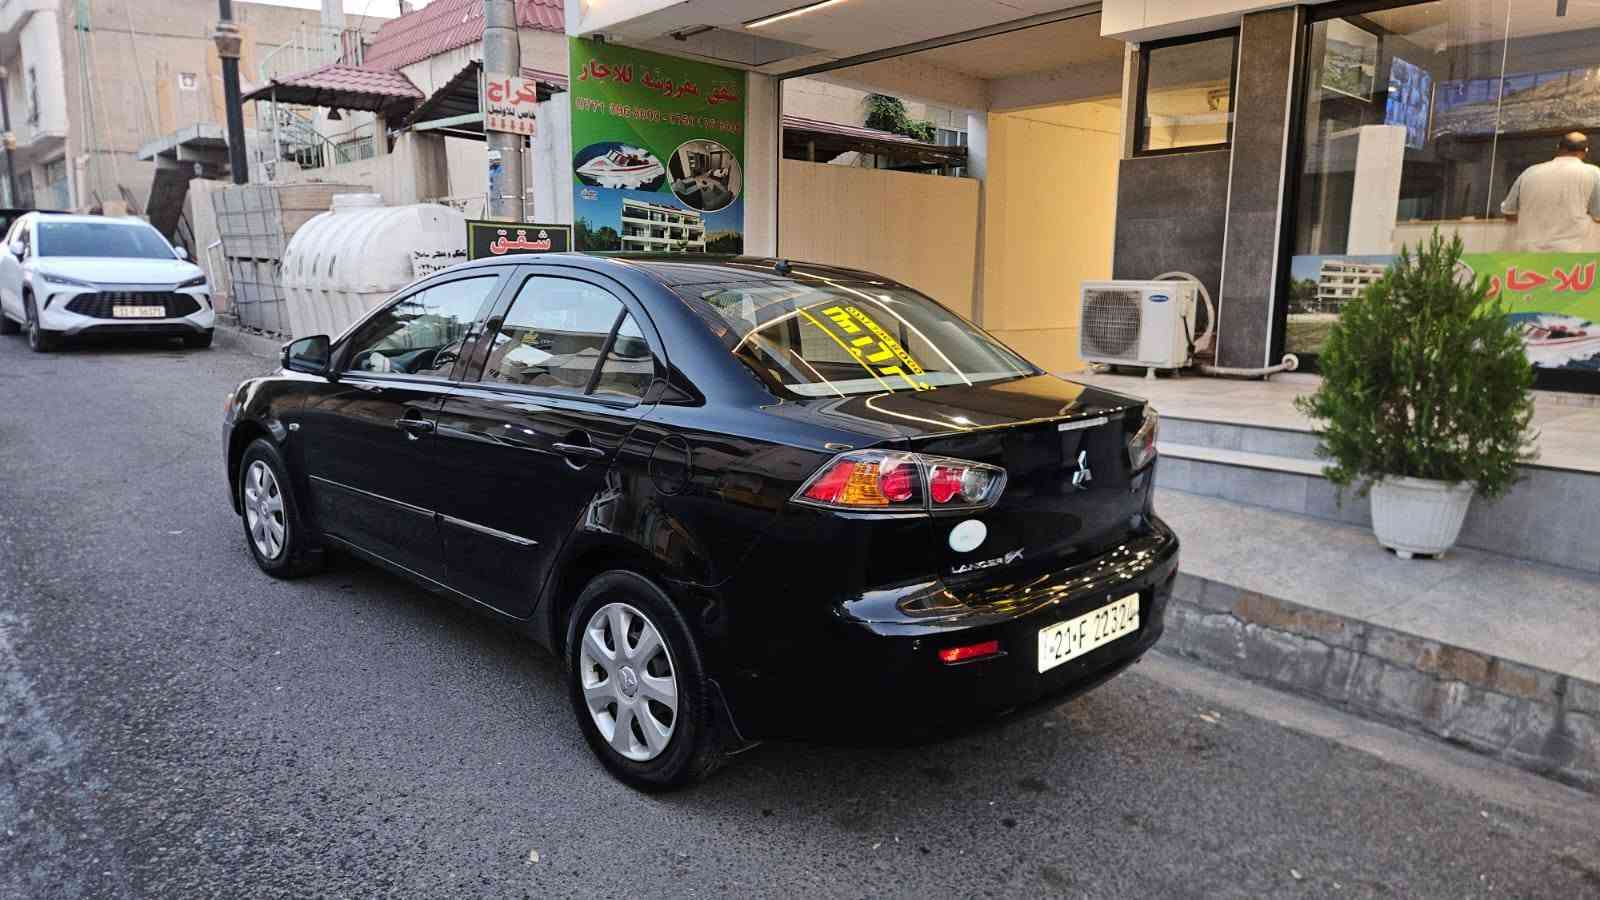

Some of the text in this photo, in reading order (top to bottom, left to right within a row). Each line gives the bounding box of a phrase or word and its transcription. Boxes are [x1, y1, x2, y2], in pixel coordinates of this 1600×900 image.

[489, 228, 551, 255] شقق
[951, 557, 1004, 574] LANCER
[1055, 627, 1072, 660] 21
[1079, 619, 1088, 650] F
